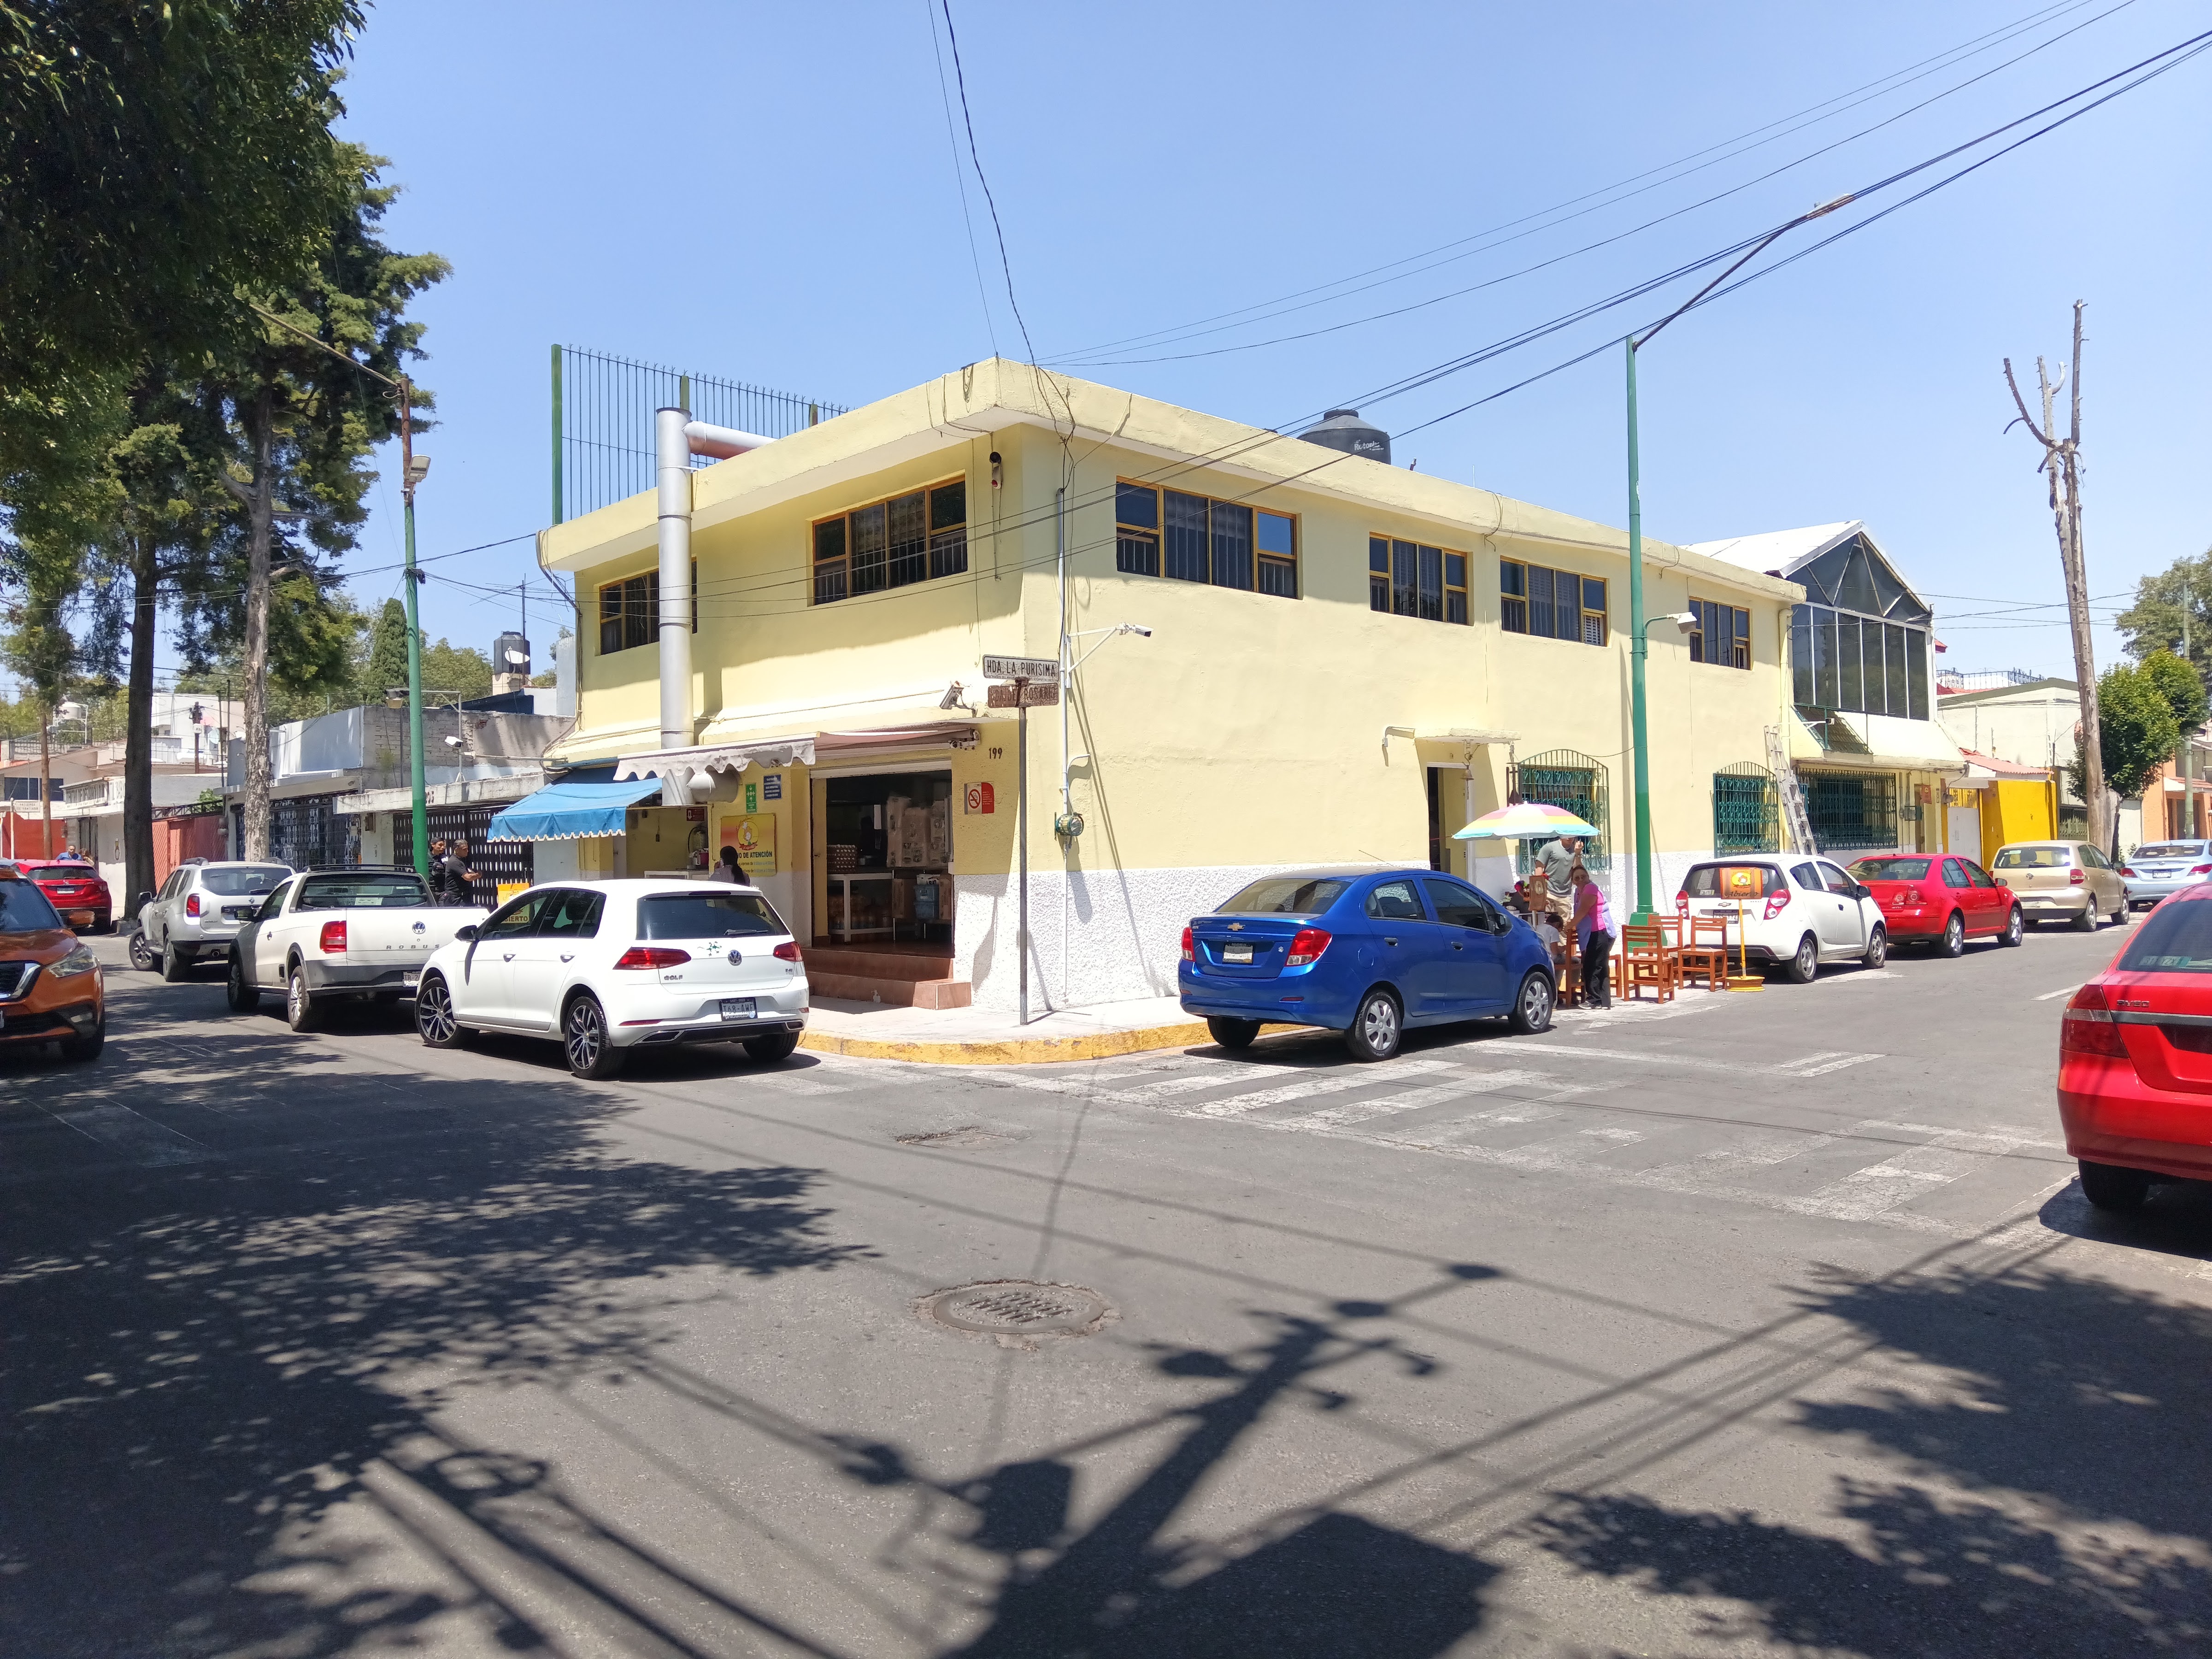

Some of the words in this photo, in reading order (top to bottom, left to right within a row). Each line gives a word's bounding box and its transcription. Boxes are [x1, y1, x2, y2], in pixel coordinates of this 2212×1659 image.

[987, 659, 1004, 673] HDA.
[1006, 661, 1016, 674] LA
[1021, 662, 1056, 677] PURISIMA
[988, 747, 1003, 759] 199
[2117, 999, 2150, 1007] AVEO
